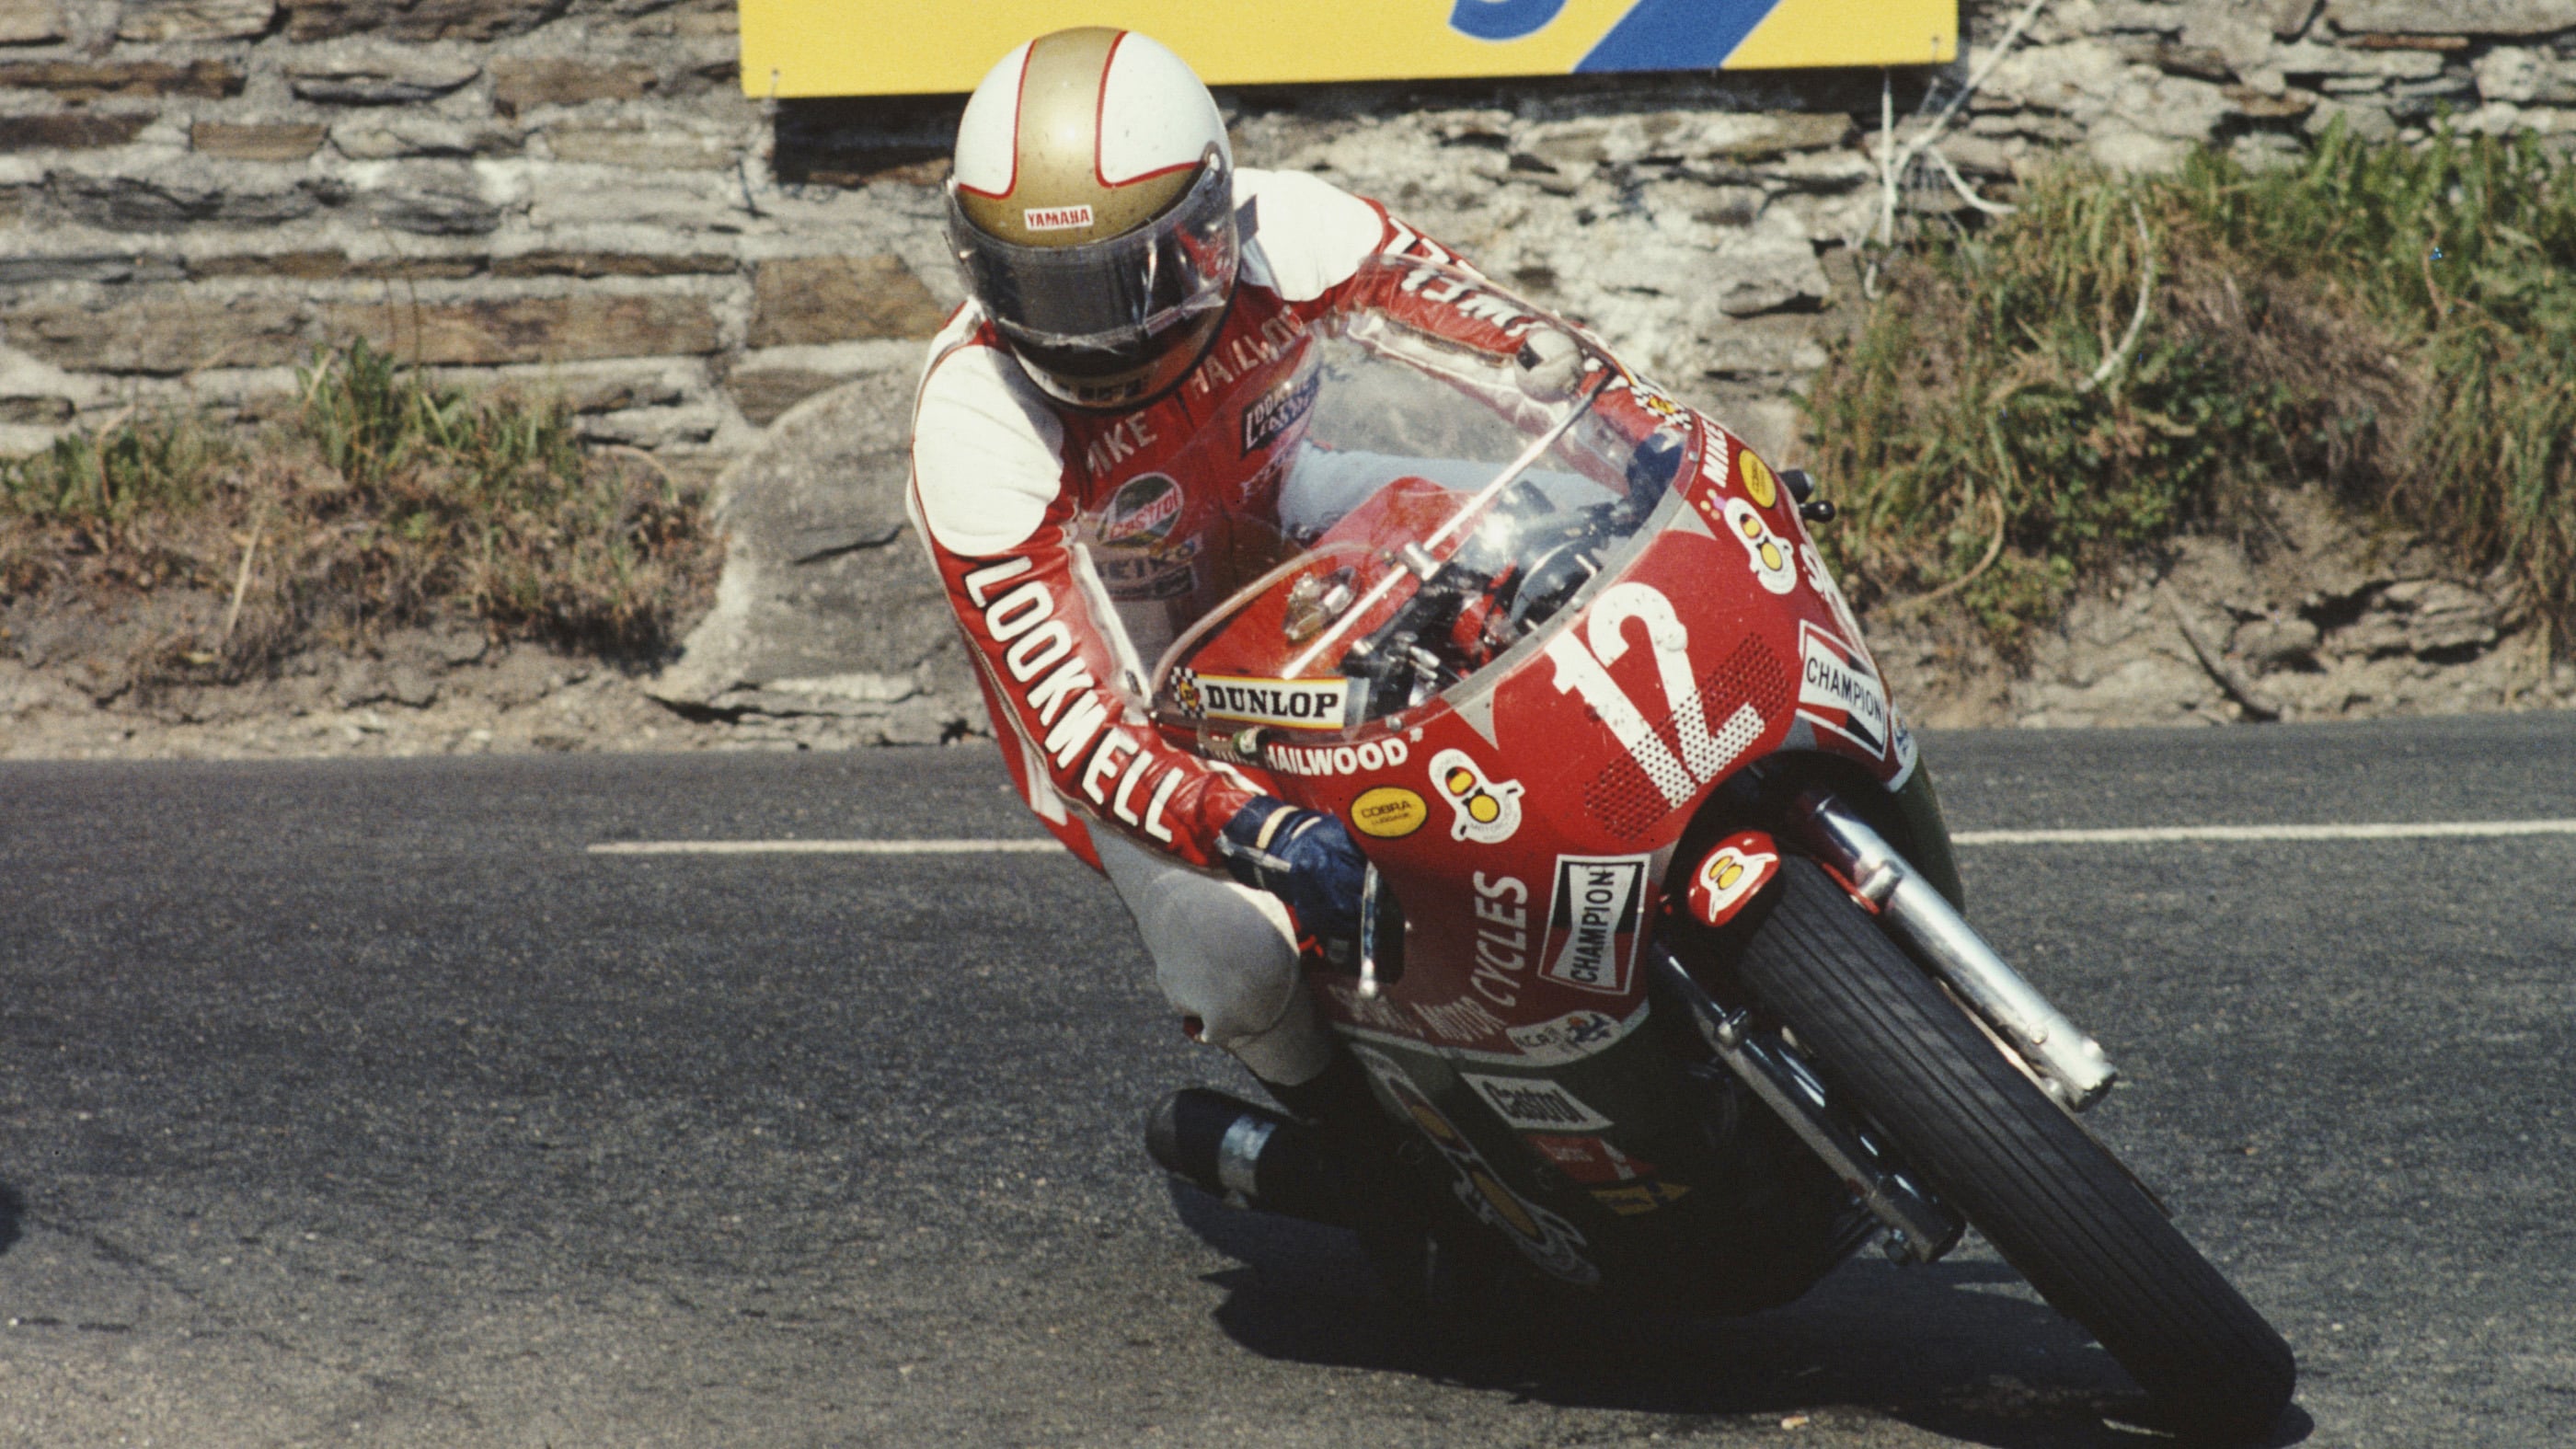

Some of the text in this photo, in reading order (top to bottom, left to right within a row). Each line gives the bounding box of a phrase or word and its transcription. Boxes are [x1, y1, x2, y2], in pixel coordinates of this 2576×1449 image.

[1027, 209, 1090, 226] YAMAHA
[1087, 410, 1158, 477] MIKE
[1701, 420, 1730, 489] MIKE
[965, 556, 1185, 844] LOOKWELL
[1205, 684, 1339, 719] DUNLOP
[1546, 581, 1765, 811] 12
[1806, 657, 1882, 722] CHAMPION
[1361, 799, 1412, 818] COBRA
[1471, 870, 1528, 1007] CYCLES
[1570, 868, 1615, 984] CHAMPION
